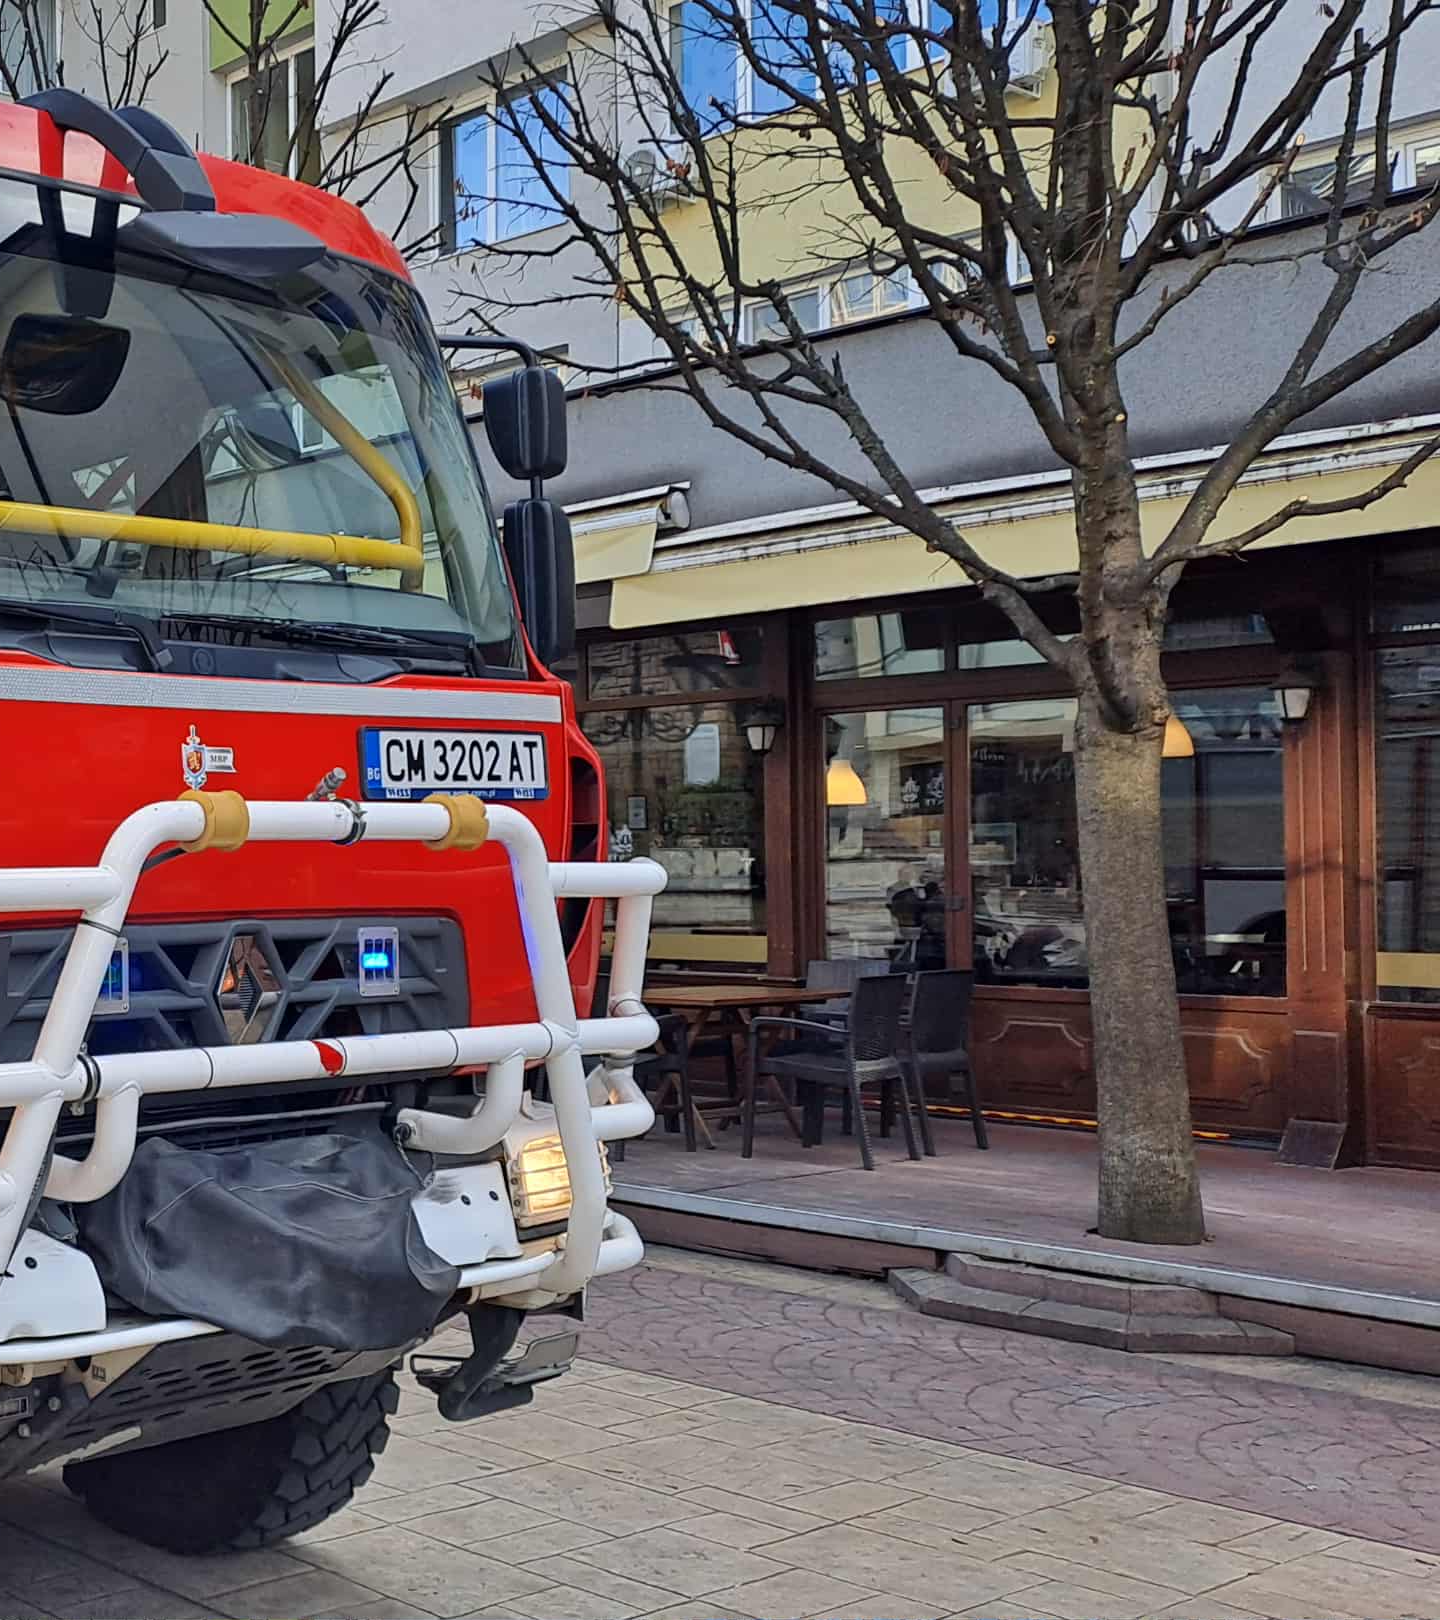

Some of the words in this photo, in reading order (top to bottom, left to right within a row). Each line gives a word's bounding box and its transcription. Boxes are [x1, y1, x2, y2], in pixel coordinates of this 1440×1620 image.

[386, 739, 426, 782] CM
[433, 740, 501, 782] 3202
[509, 740, 538, 782] AT
[367, 769, 380, 780] BG
